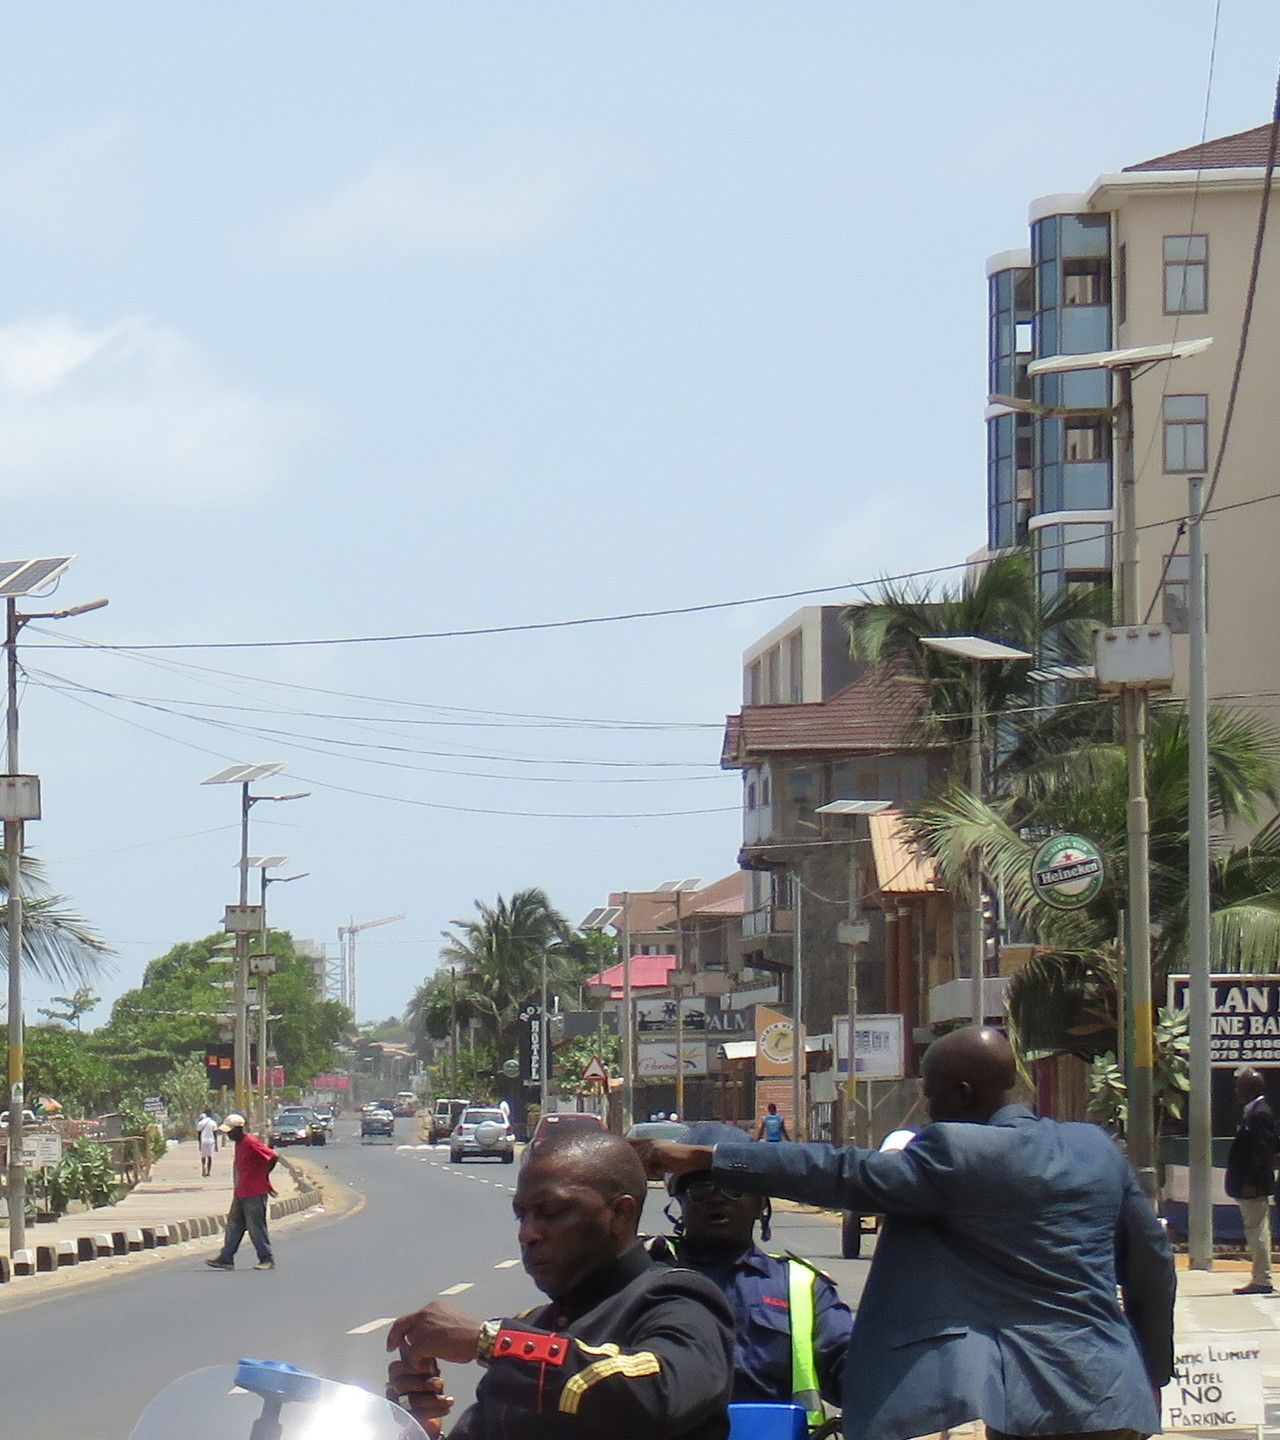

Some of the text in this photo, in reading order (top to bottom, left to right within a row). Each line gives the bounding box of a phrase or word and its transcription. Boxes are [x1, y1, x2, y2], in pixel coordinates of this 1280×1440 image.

[1042, 862, 1099, 883] Heineken
[1249, 1016, 1280, 1035] BA
[530, 1020, 540, 1080] HOTEL
[1207, 1345, 1260, 1362] LUMLEY
[1175, 1367, 1223, 1386] HOTEL
[1181, 1386, 1222, 1405] NO
[1169, 1407, 1237, 1427] PARKING
